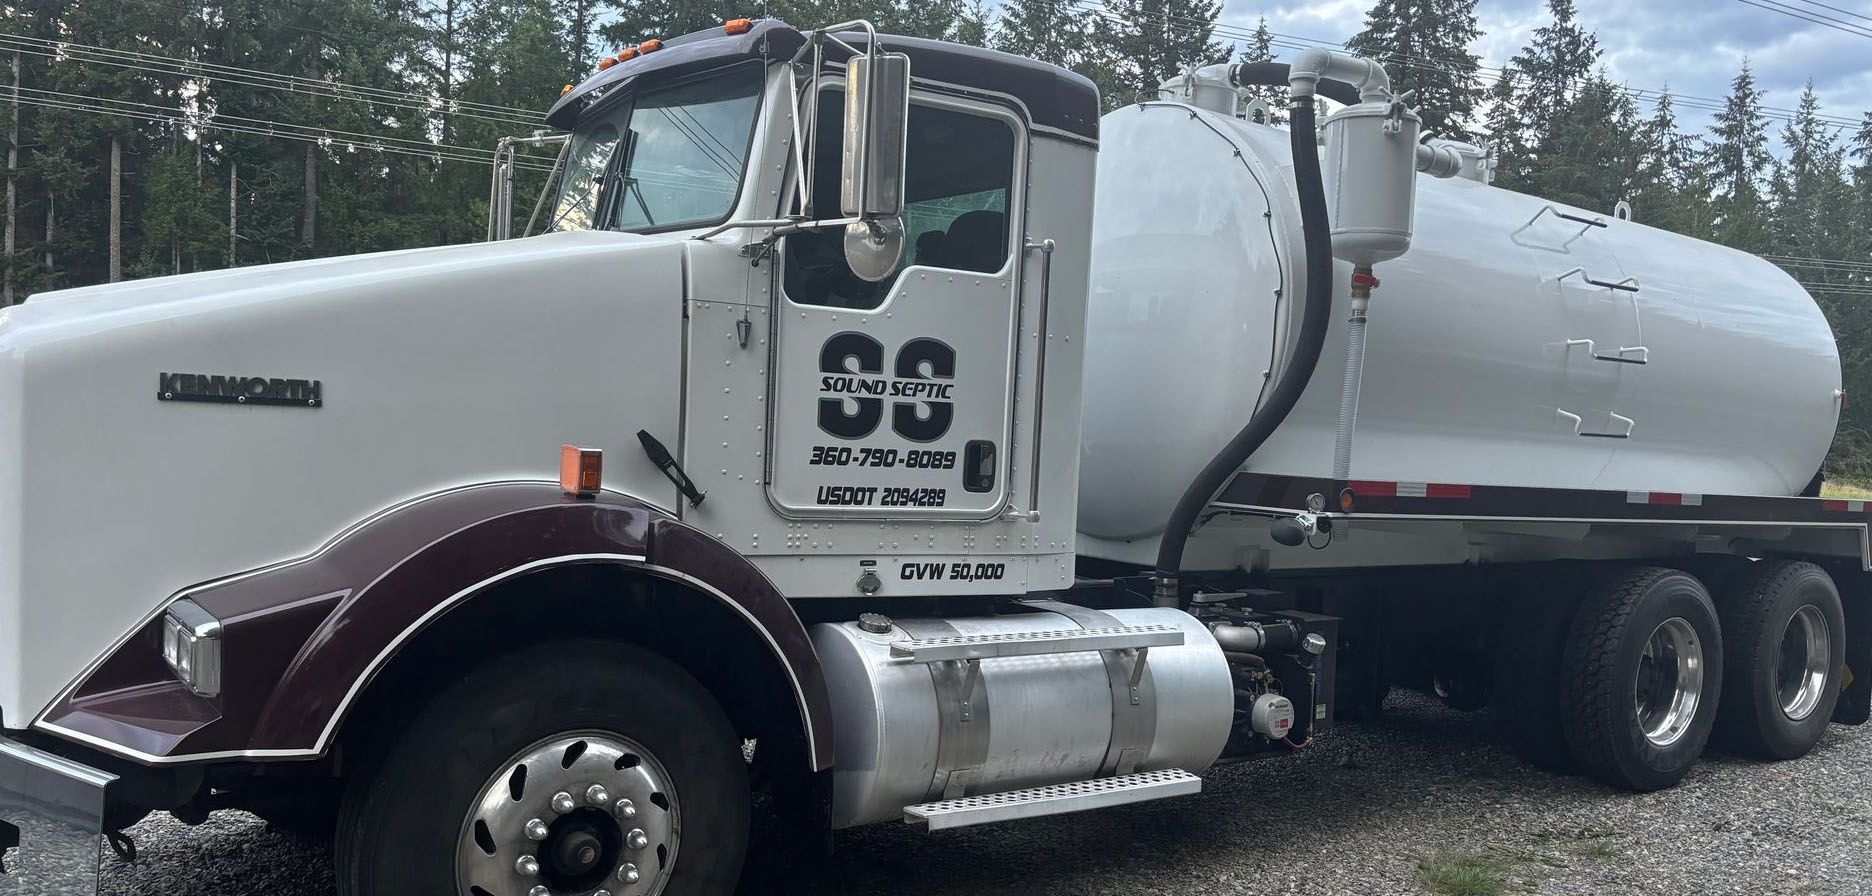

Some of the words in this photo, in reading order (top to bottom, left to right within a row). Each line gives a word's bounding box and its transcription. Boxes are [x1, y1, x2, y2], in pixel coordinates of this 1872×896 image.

[159, 372, 321, 401] KENWORTH
[820, 376, 887, 395] SOUND
[889, 381, 954, 399] SEPTIC
[809, 446, 956, 469] 360-790-8089
[817, 486, 877, 505] USDOT
[880, 488, 946, 506] 2094289
[900, 563, 945, 580] GVW
[949, 563, 1005, 582] 50,000
